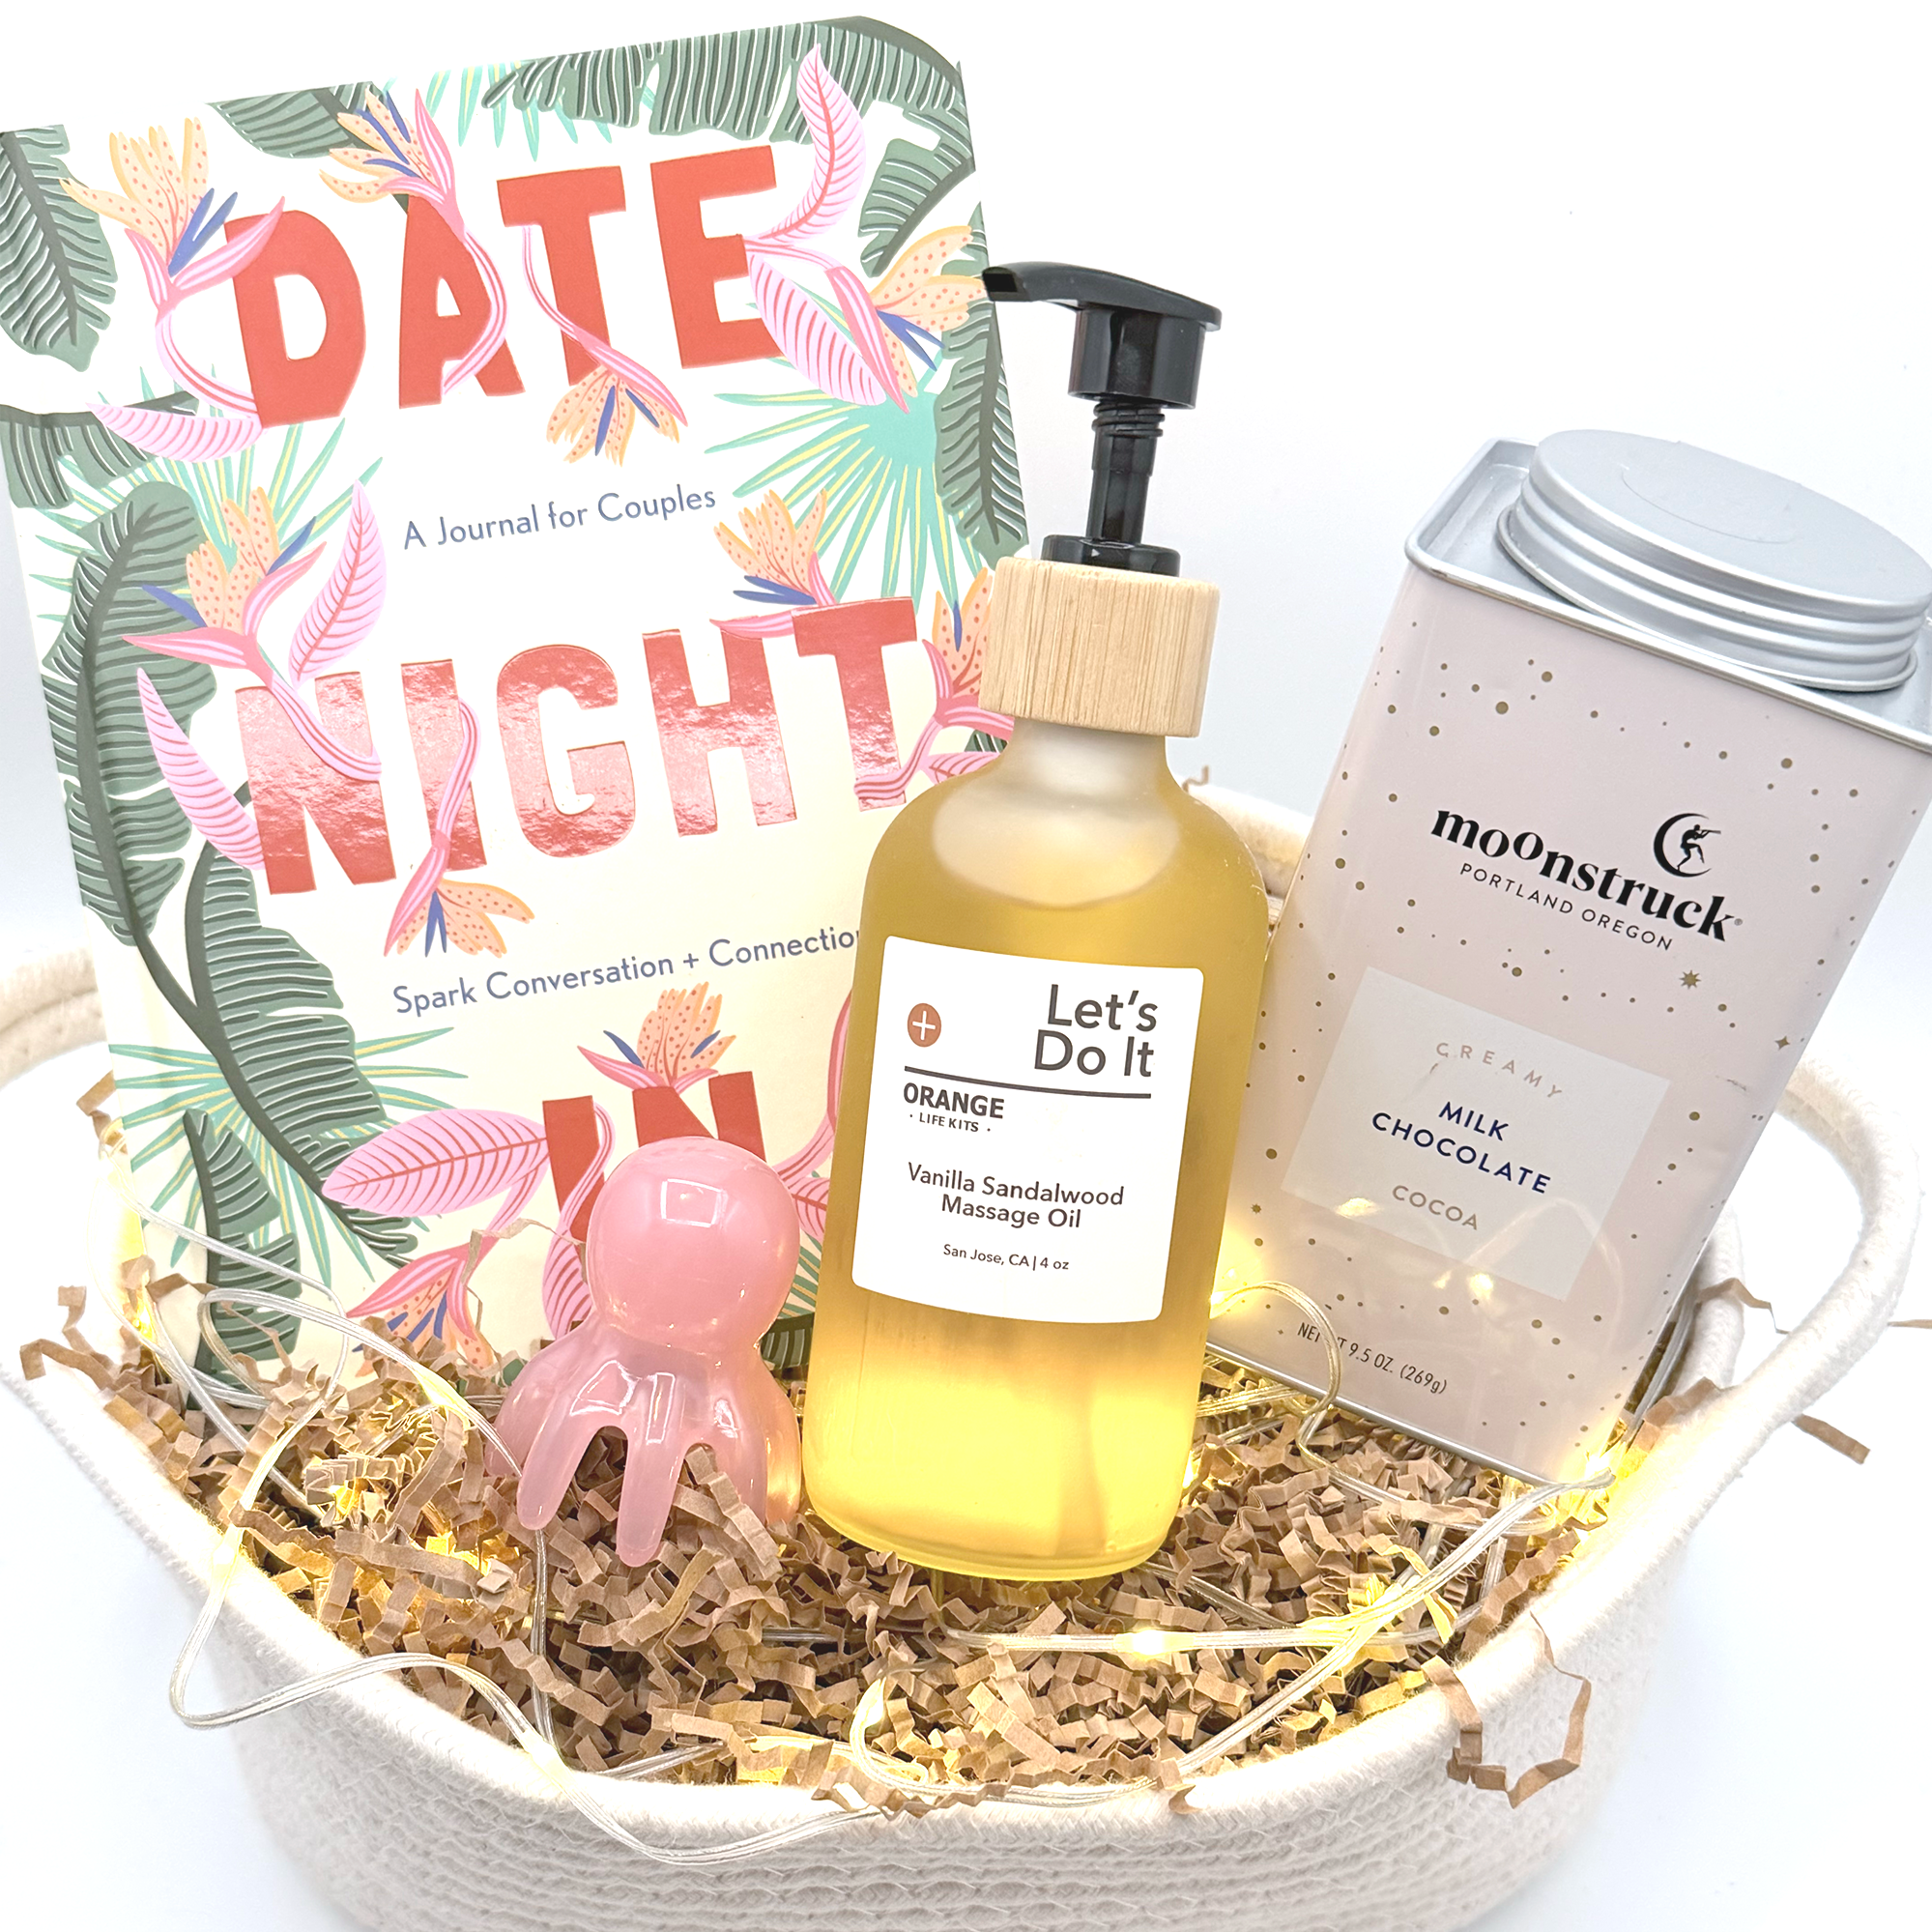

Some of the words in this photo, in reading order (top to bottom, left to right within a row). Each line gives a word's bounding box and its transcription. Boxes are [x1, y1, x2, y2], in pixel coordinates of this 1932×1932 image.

[223, 144, 781, 428] DATE
[404, 520, 427, 550] A
[438, 504, 539, 545] Journal
[548, 501, 588, 530] for
[597, 483, 716, 521] Couples
[235, 595, 918, 895] NIGHT
[1430, 809, 1735, 942] moonstruck
[1459, 862, 1574, 914] PORTLAND
[1581, 908, 1673, 951] OREGON
[392, 976, 476, 1017] Spark
[485, 951, 675, 999] Conversation
[708, 925, 860, 967] Connectio
[1034, 1029, 1107, 1076] Do
[1123, 1036, 1155, 1078] It
[1435, 1041, 1563, 1099] CREAMY
[903, 1082, 1005, 1119] ORANGE
[919, 1112, 945, 1128] LIFE
[948, 1117, 980, 1133] KITS
[1437, 1100, 1509, 1142] MILK
[1370, 1110, 1551, 1195] CHOCOLATE
[908, 1162, 975, 1193] Vanilla
[982, 1175, 1125, 1206] Sandalwood
[1392, 1184, 1479, 1231] COCOA
[941, 1194, 1040, 1229] Massage
[1047, 1207, 1081, 1228] Oil
[943, 1244, 966, 1258] San
[970, 1249, 1005, 1266] Jose,
[1009, 1254, 1030, 1267] CA
[1053, 1260, 1070, 1270] oz
[1348, 1342, 1371, 1363] 9.5
[1373, 1353, 1394, 1373] OZ.
[1399, 1364, 1448, 1395] (269g)
